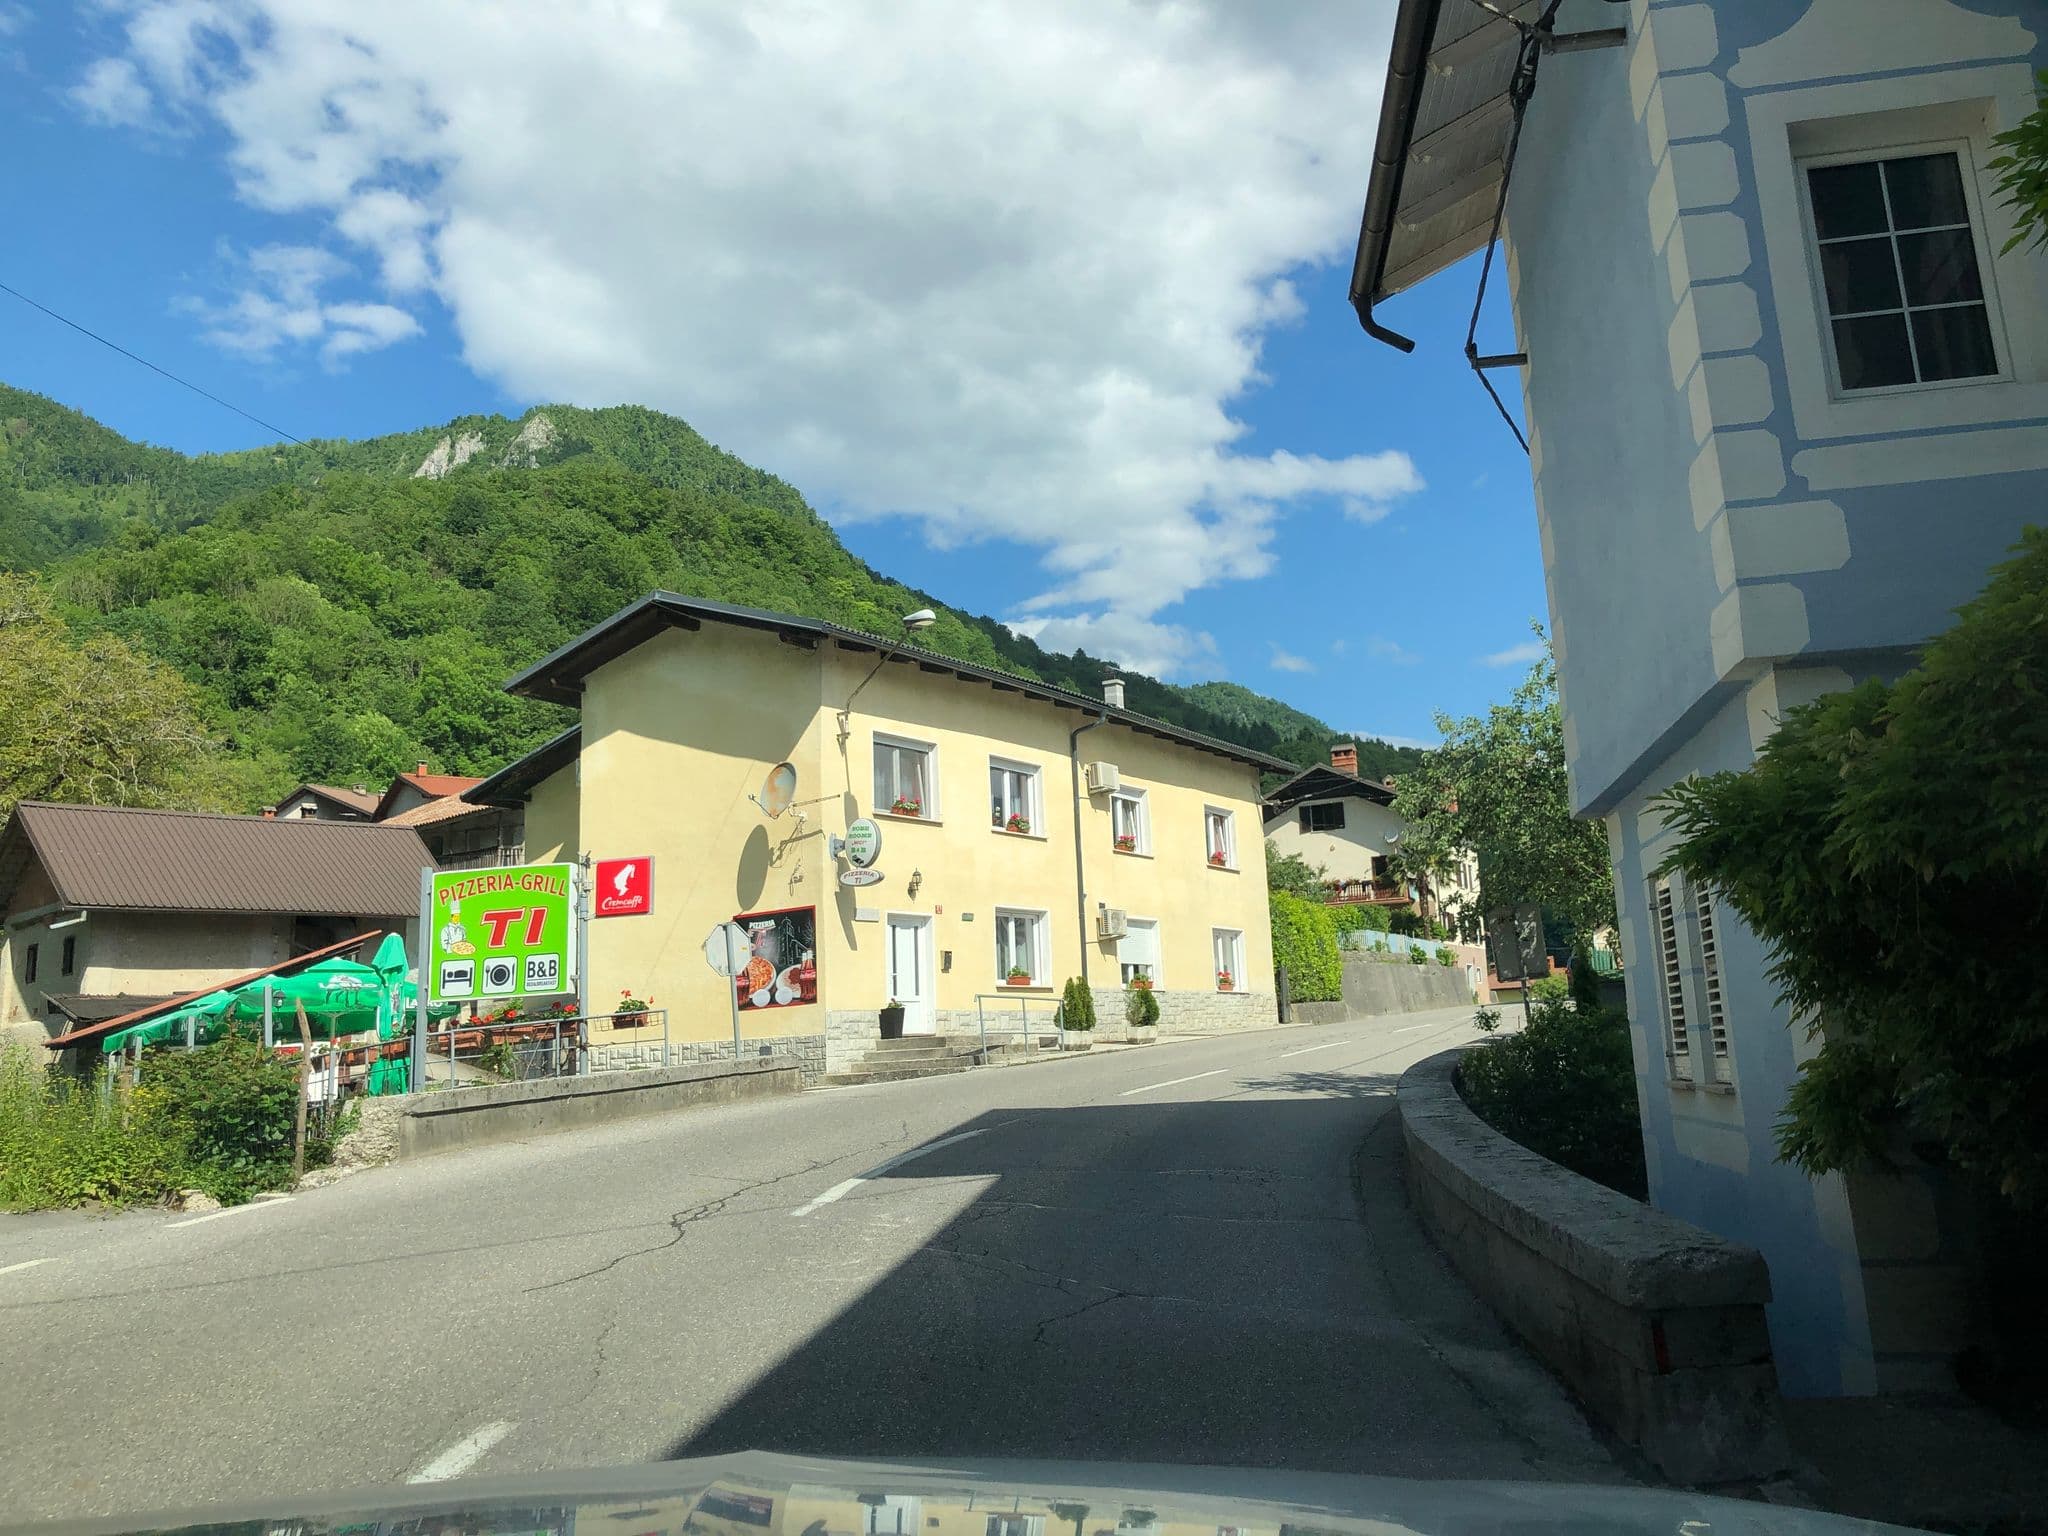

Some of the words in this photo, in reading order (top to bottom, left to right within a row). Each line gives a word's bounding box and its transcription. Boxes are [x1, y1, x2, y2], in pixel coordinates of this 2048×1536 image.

[843, 871, 875, 880] PIZZERIA
[438, 874, 566, 905] PIZZERIA-GRILL
[480, 905, 548, 949] TI
[748, 919, 776, 929] PIZZERIA
[527, 960, 557, 978] B&B
